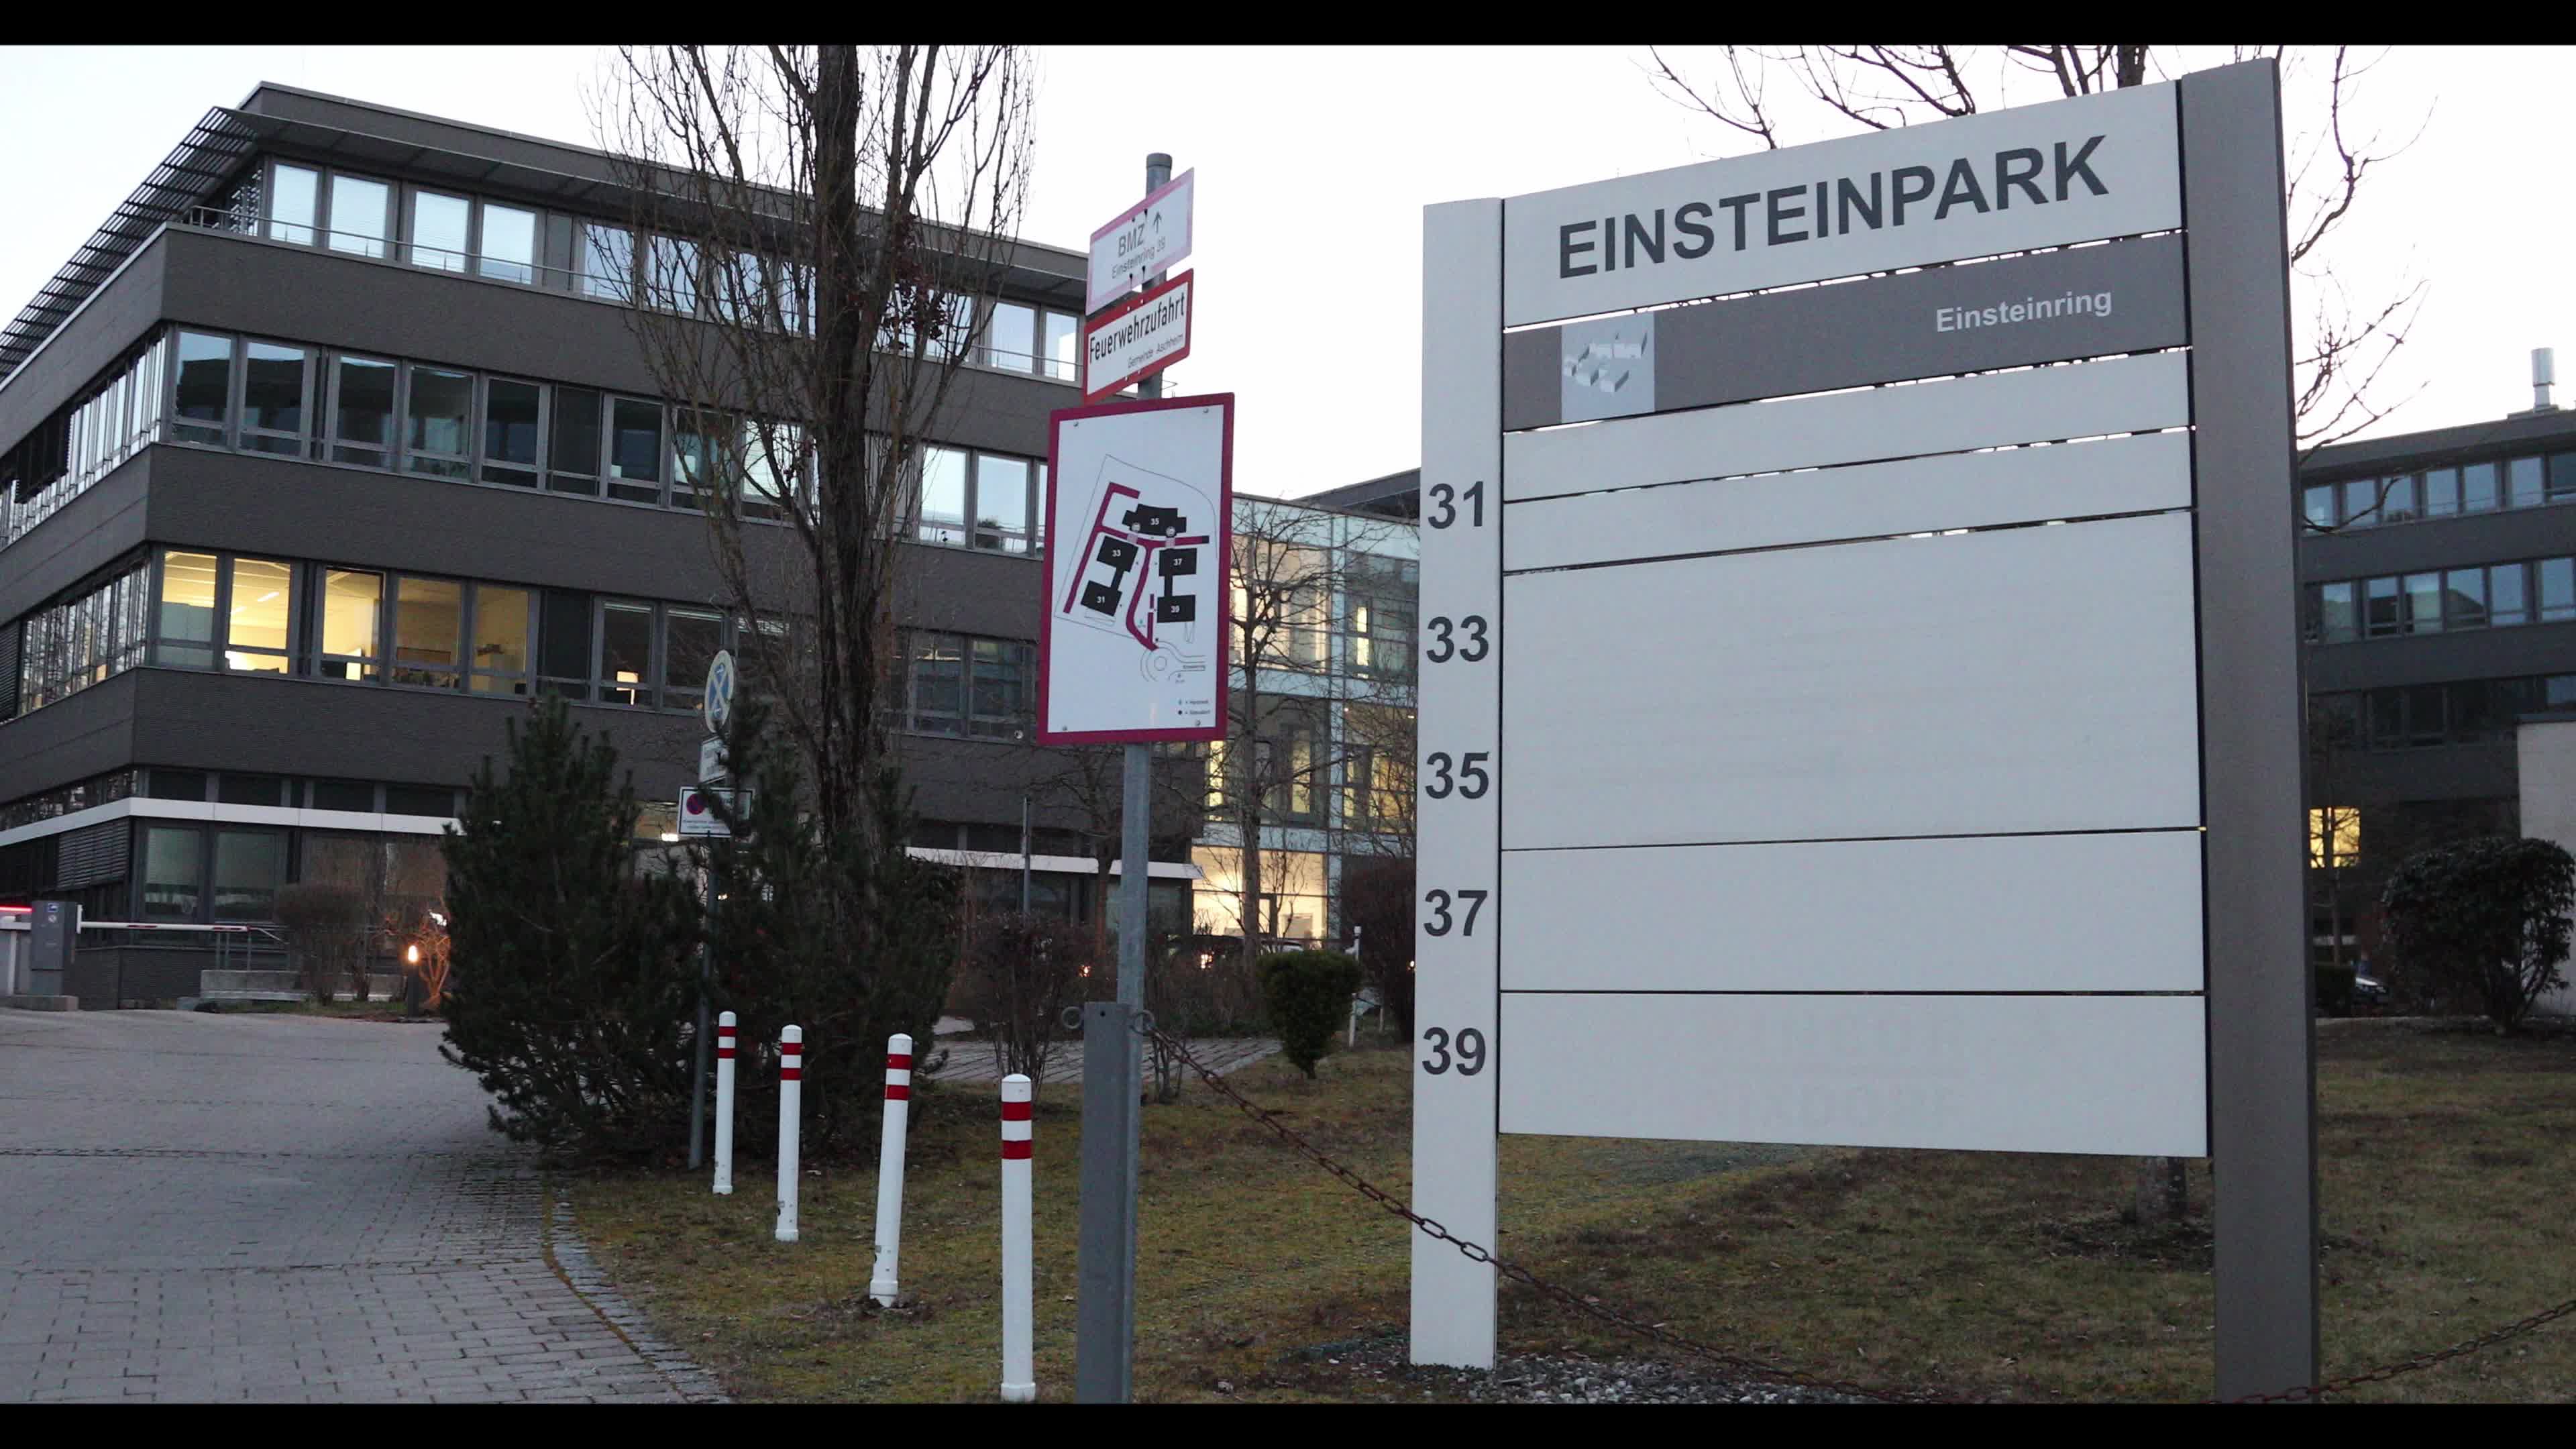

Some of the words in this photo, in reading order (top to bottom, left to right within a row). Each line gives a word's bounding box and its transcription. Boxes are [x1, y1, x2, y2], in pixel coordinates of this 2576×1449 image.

[1560, 134, 2109, 279] EINSTEINPARK
[1118, 223, 1144, 258] BMZ
[1089, 292, 1185, 364] Feuerwehrzufahrt
[1937, 290, 2112, 333] Einsteinring
[1150, 517, 1160, 526] 35
[1428, 481, 1483, 529] 31
[1112, 549, 1122, 557] 33
[1173, 557, 1183, 566] 37
[1171, 605, 1180, 613] 39
[1427, 615, 1489, 663] 33
[1426, 751, 1489, 799] 35
[1424, 889, 1487, 936] 37
[1422, 1027, 1485, 1075] 39
